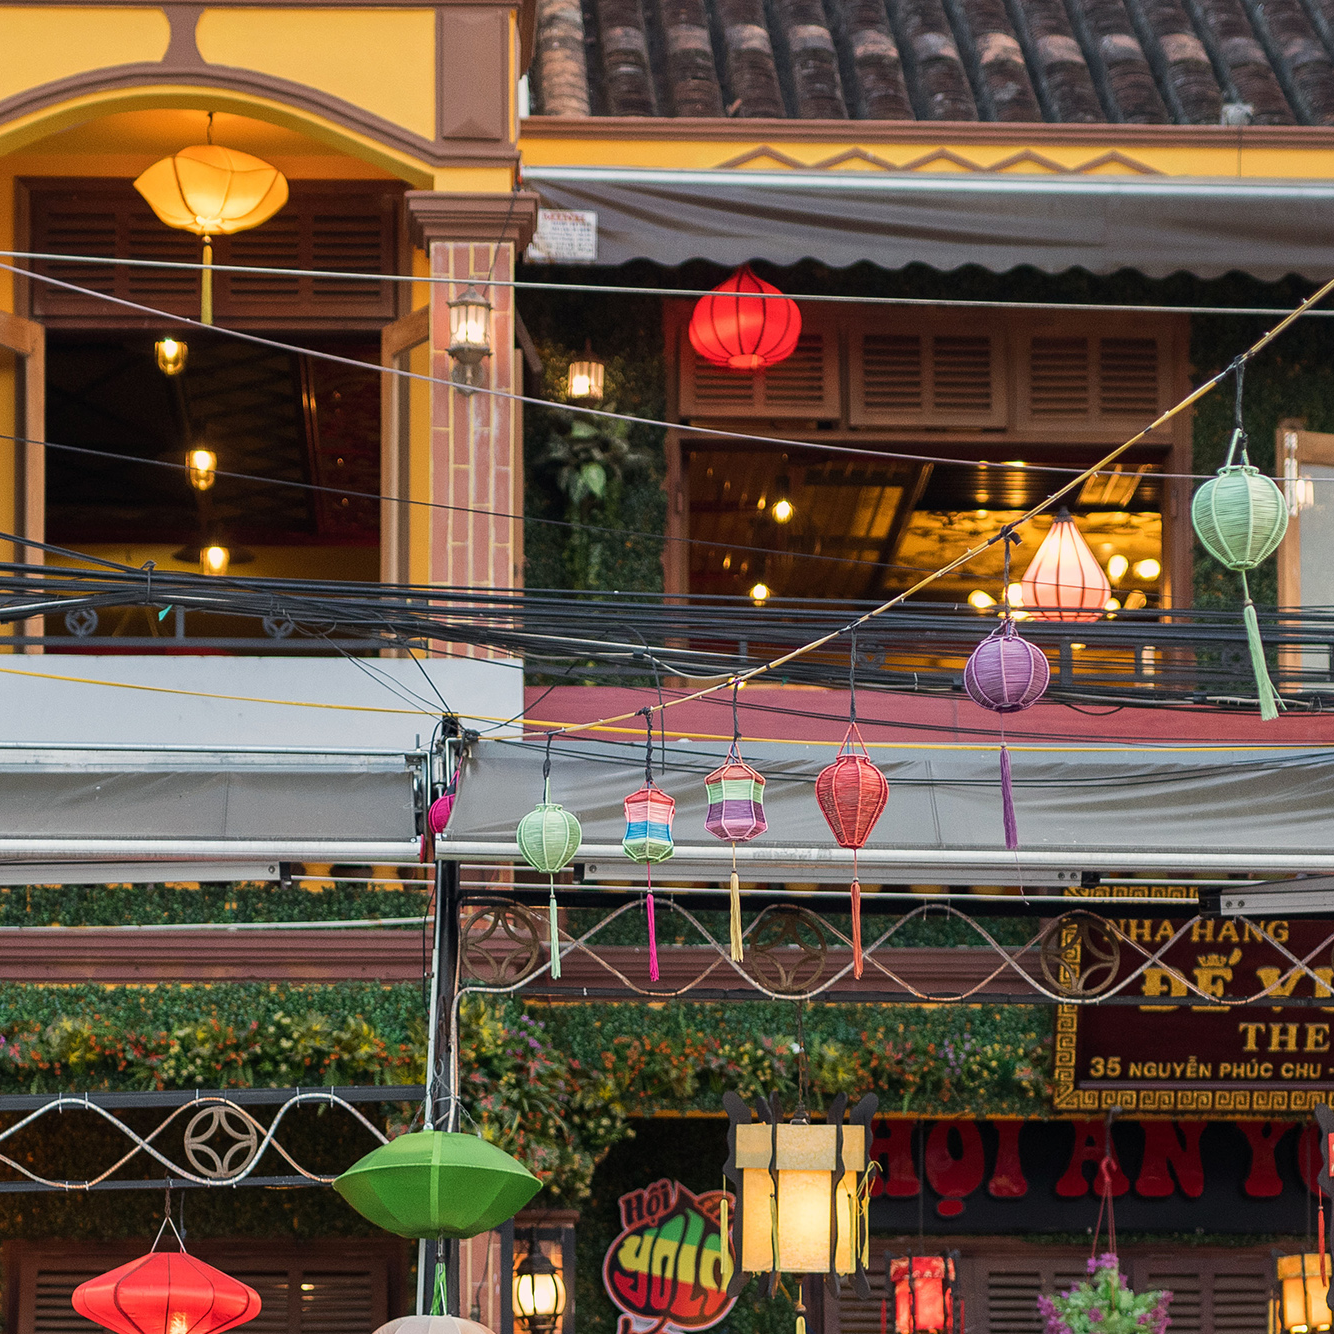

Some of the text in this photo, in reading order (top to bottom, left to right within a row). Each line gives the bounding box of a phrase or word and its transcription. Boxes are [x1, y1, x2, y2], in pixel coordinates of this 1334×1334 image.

[1239, 1022, 1331, 1052] THE
[1089, 1057, 1122, 1077] 35
[1129, 1056, 1212, 1078] NGUYỄN
[1219, 1059, 1274, 1078] PHÚC
[1281, 1062, 1322, 1078] CHU
[1056, 1120, 1208, 1197] AN
